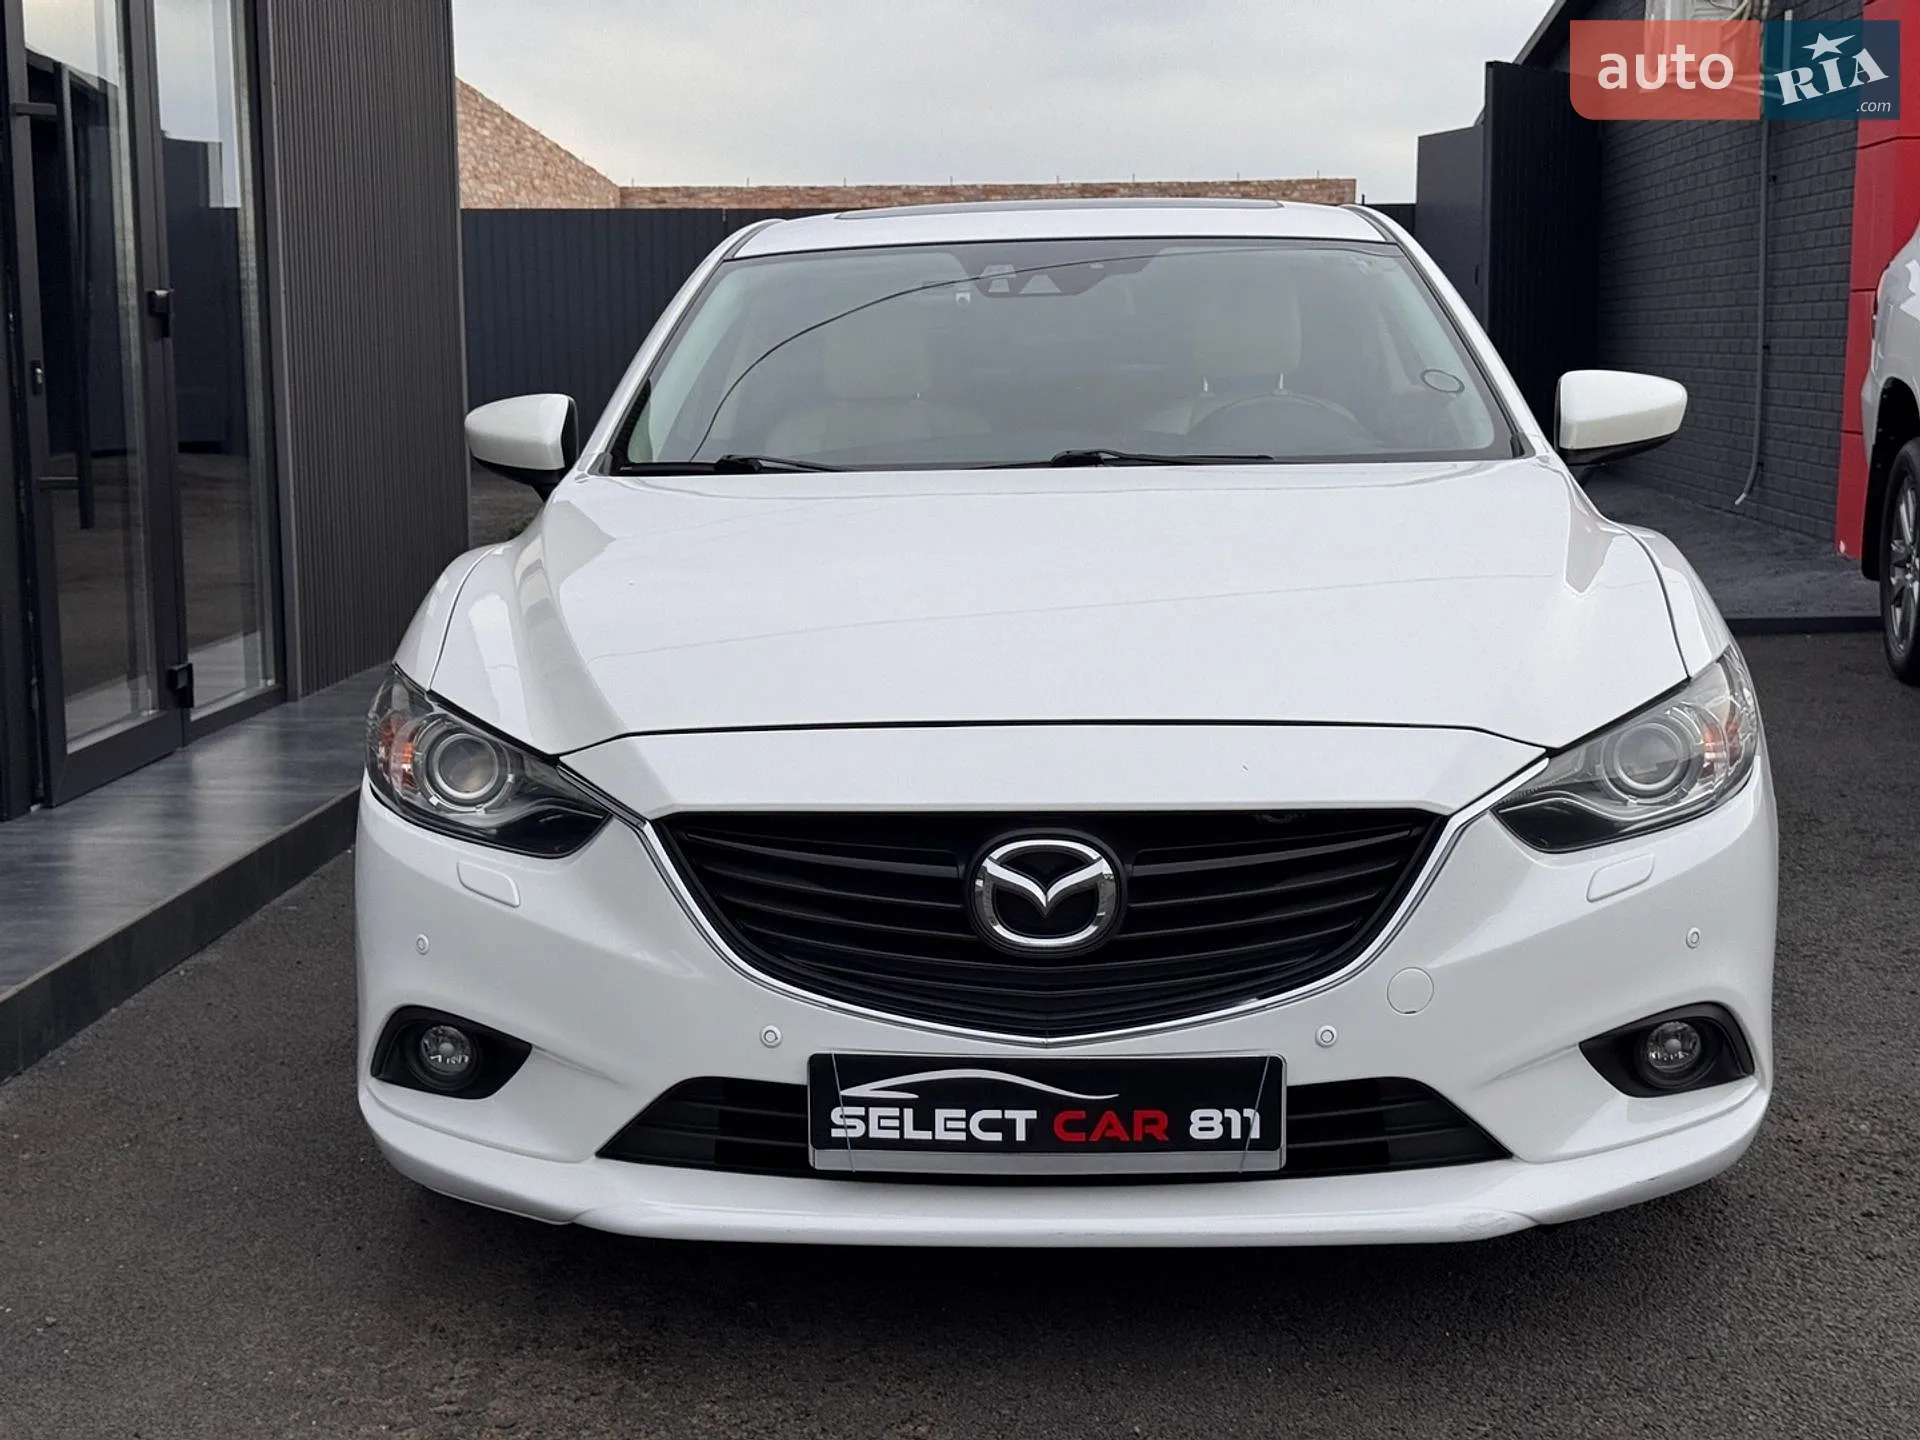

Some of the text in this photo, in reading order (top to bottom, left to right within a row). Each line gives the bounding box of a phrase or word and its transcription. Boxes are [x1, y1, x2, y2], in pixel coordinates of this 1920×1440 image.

[830, 1106, 1261, 1142] SELECT CAR 811
